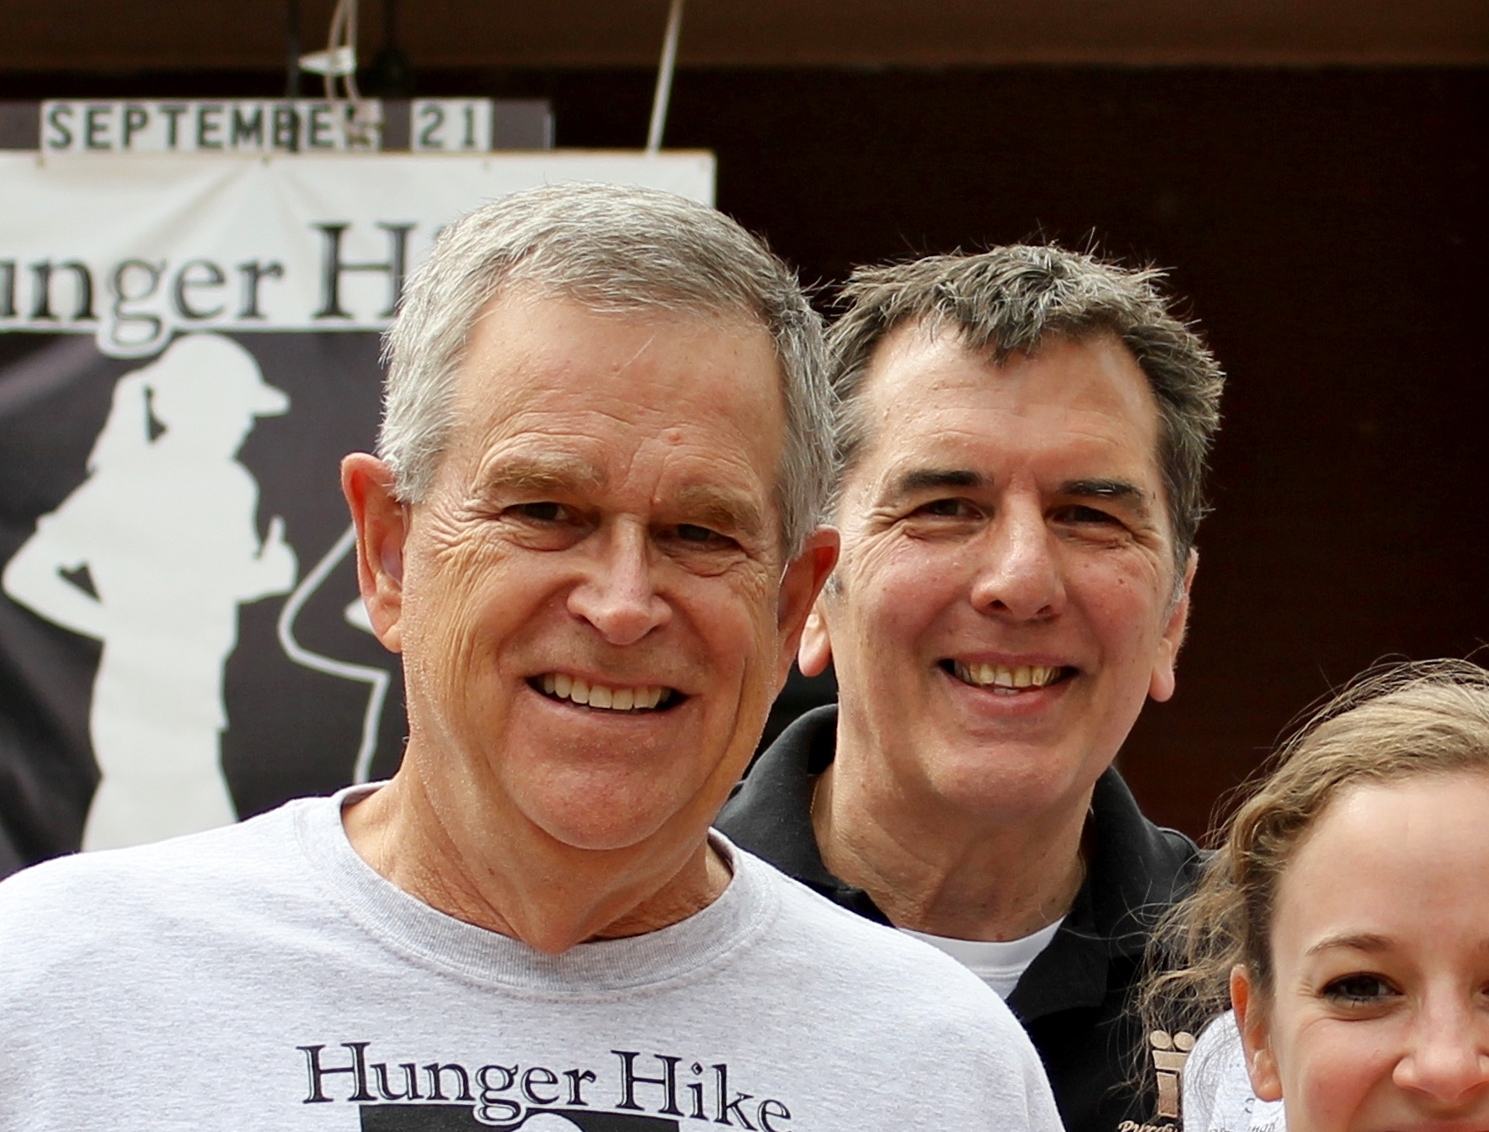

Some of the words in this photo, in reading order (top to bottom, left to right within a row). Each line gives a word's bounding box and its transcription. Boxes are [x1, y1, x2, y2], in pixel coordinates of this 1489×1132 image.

[418, 106, 477, 149] 21
[0, 257, 285, 346] nger
[296, 1042, 597, 1121] Hunger
